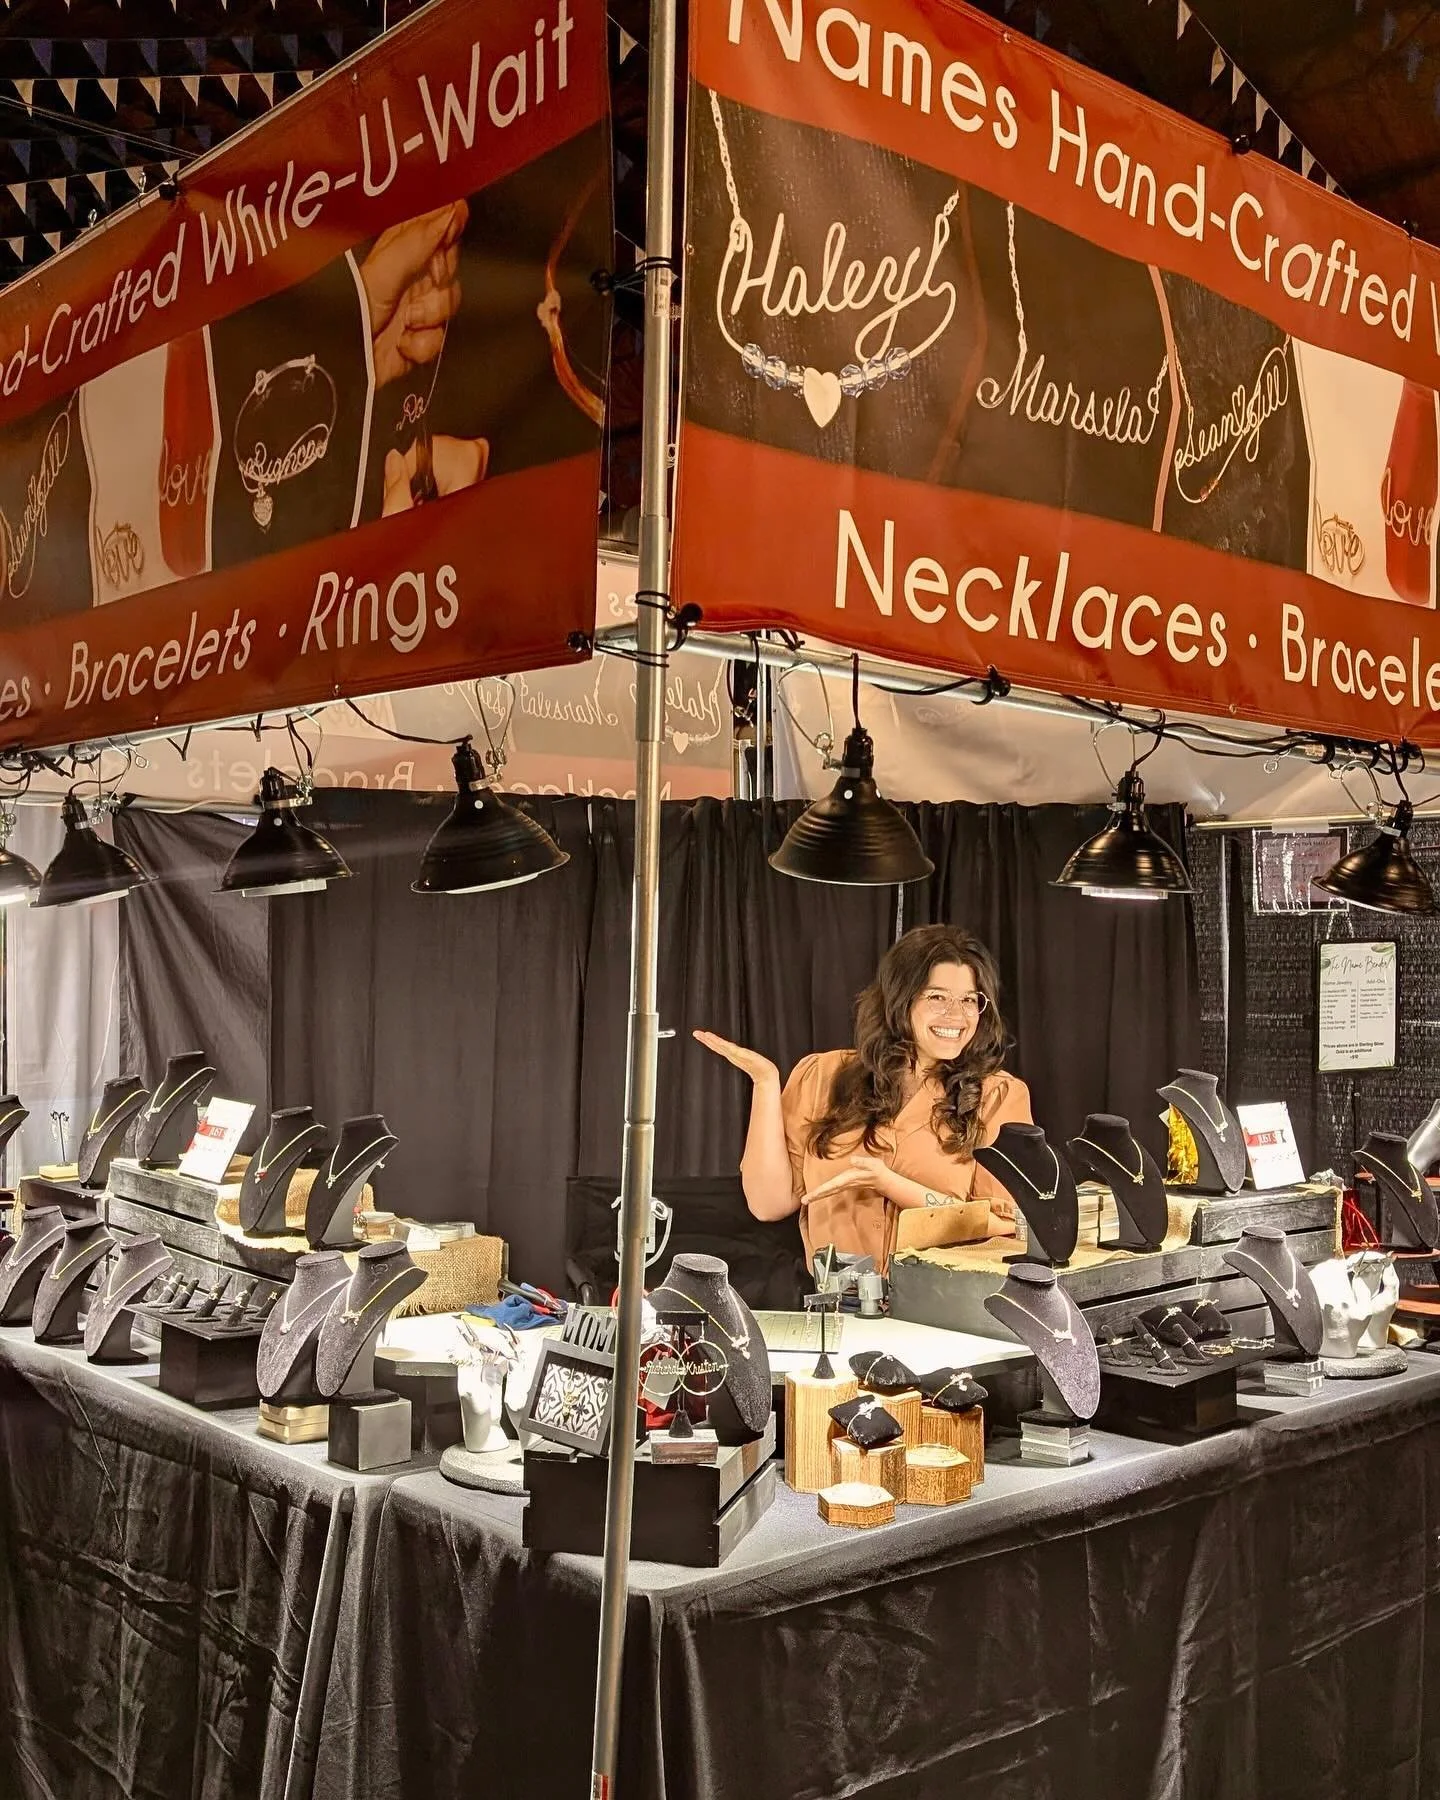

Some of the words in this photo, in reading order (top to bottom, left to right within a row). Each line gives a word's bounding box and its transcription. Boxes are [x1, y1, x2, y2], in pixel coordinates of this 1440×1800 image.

[0, 221, 185, 397] d-Crafted
[200, 0, 574, 285] While-U-Wait
[1048, 88, 1417, 343] Hand-Crafted
[64, 608, 257, 710] Bracelets
[300, 564, 459, 653] Rings
[835, 509, 1228, 668] Necklaces
